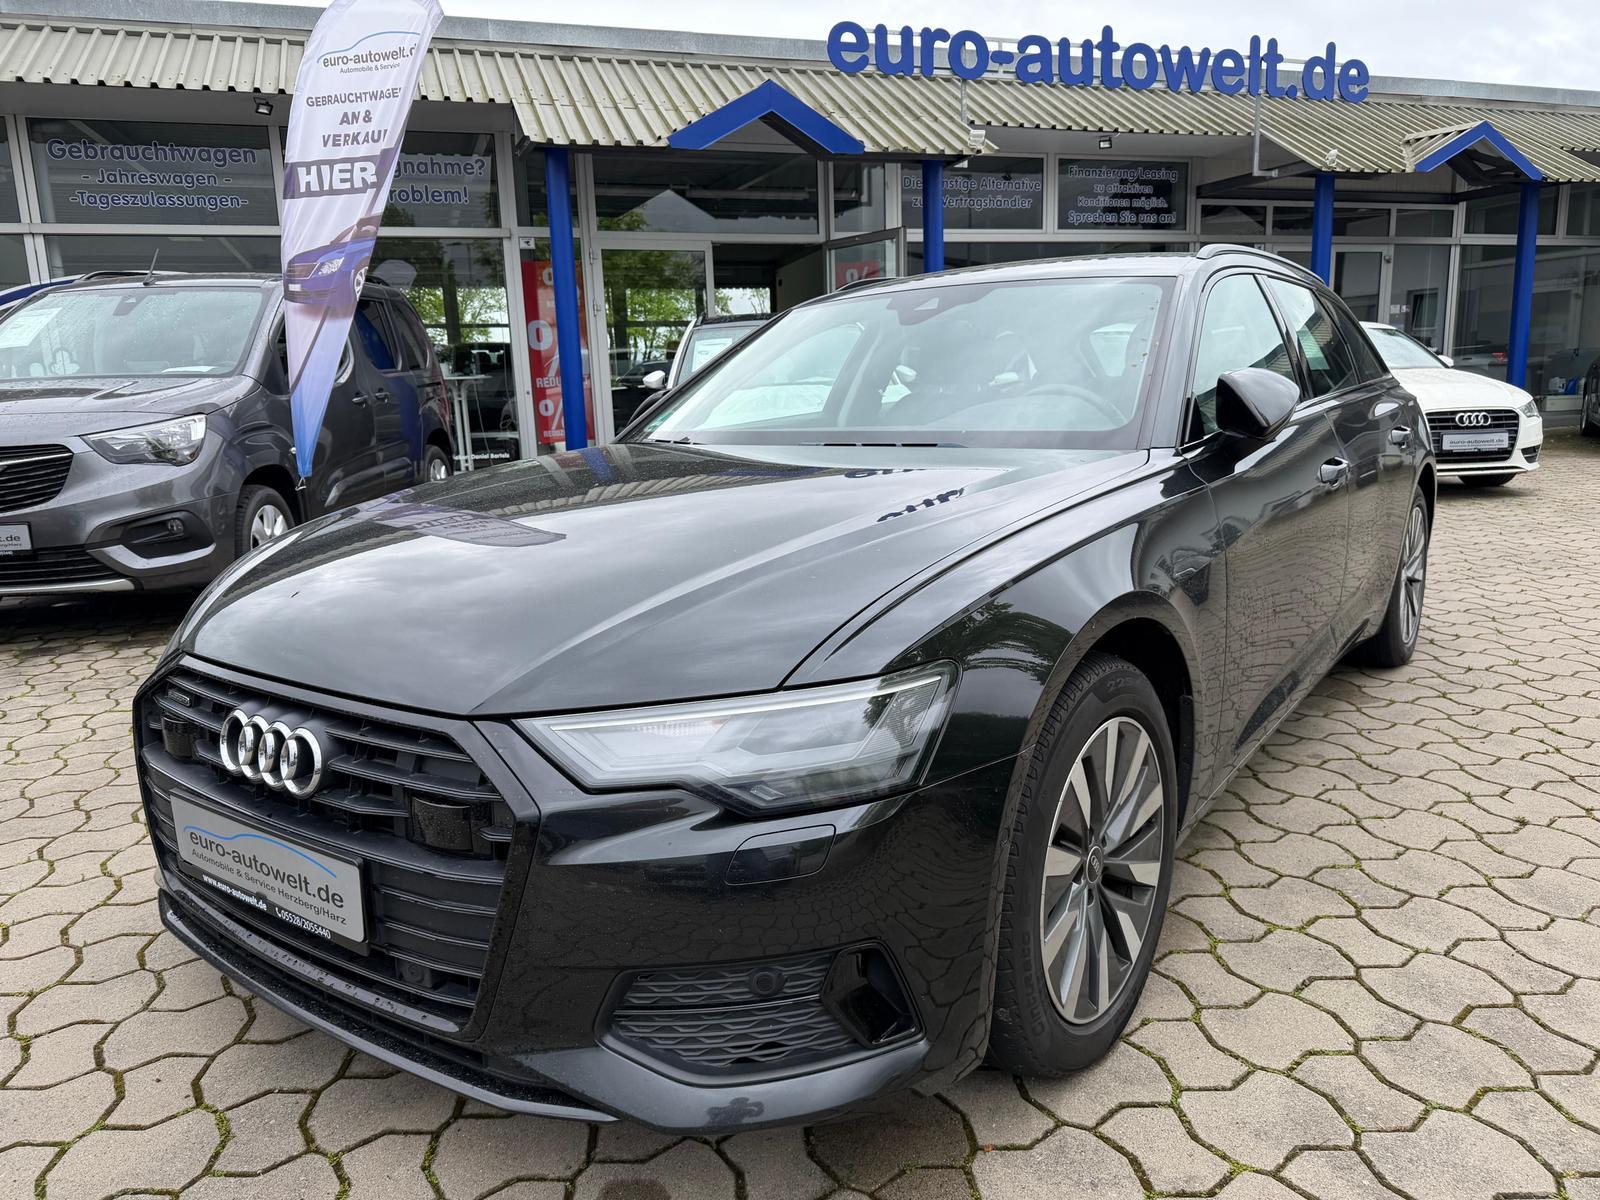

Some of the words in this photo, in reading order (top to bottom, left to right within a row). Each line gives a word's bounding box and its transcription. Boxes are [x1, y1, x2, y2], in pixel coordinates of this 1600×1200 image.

[323, 43, 416, 67] euro-autowelt.
[827, 21, 1370, 102] euro-autowelt.de
[340, 65, 373, 74] Automobile
[339, 111, 360, 125] AN
[362, 110, 373, 123] &
[47, 139, 256, 168] Gebrauchtwagen
[297, 161, 378, 193] HIER
[394, 157, 485, 179] gnahme?
[1068, 165, 1178, 183] Finanzierung/Leasing
[97, 169, 217, 189] Jahreswagen
[980, 177, 1041, 191] Alternative
[1094, 184, 1105, 193] zu
[1106, 183, 1154, 194] attraktiven
[70, 190, 248, 211] -Tageszulassungen-
[389, 184, 469, 205] roblem!
[1077, 196, 1131, 207] Konditionen
[1132, 196, 1168, 210] möglich.
[1068, 210, 1118, 225] Sprechen
[1120, 210, 1137, 223] Sie
[1138, 212, 1157, 223] uns
[1159, 211, 1177, 223] an!
[189, 830, 344, 908] euro-autowelt.de
[192, 849, 235, 875] Automobile
[236, 869, 243, 878] &
[244, 871, 276, 893] Service
[278, 886, 347, 925] Herzberg/Harz
[202, 873, 267, 911] www.euro-autowelt.de
